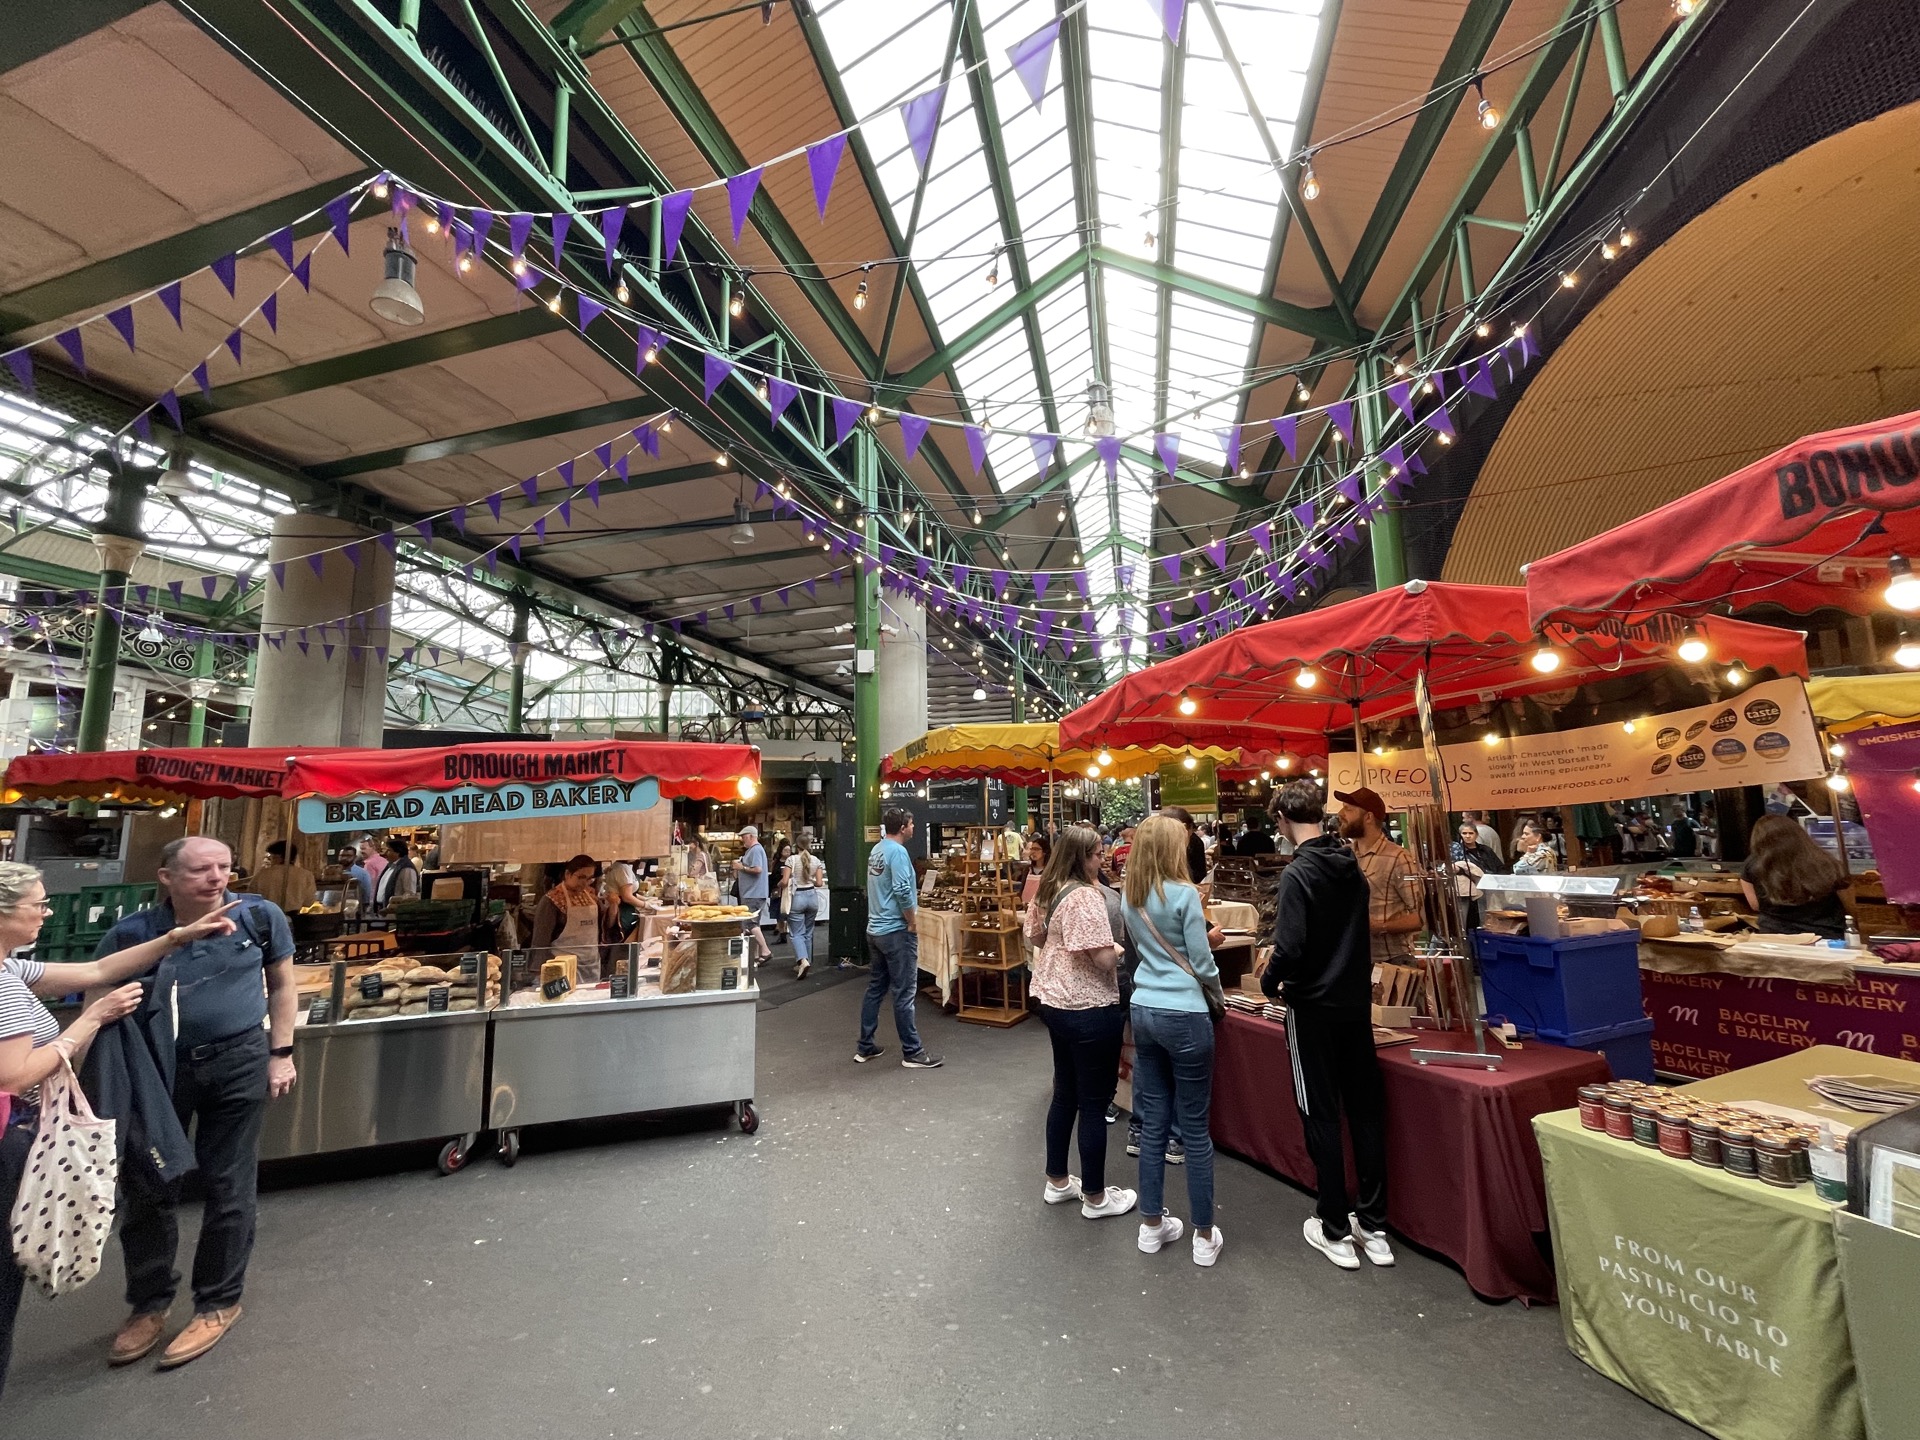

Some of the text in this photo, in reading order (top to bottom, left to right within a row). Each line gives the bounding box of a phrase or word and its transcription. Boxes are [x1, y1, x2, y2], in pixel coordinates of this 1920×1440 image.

[1562, 613, 1708, 645] OUGH MART
[1746, 708, 1780, 719] taste
[444, 749, 627, 780] BOROUGH MARKET
[1487, 754, 1518, 762] Artisan
[1520, 748, 1574, 759] Charcuterie
[1532, 759, 1555, 767] West
[1558, 755, 1590, 765] Dorset
[1593, 754, 1605, 762] by
[135, 755, 287, 788] BOROUGH MARKET
[1337, 764, 1473, 786] CAPREOUS
[1490, 762, 1613, 779] award winning epicureans
[1491, 775, 1631, 796] CAPREOLUSFINEFOODS.CO.UK
[325, 783, 636, 824] BREAD AHEAD BAKERY
[1652, 972, 1723, 990] BAKERY
[1796, 988, 1907, 1013] & BAKERY
[1719, 1008, 1810, 1032] BAGELRY
[1718, 1023, 1816, 1048] & BAKERY
[1650, 1039, 1732, 1064] BAGELRY
[1614, 1235, 1758, 1305] FROM OUR
[1598, 1256, 1789, 1347] PASTIFICIO TO
[1621, 1291, 1783, 1378] YOUR TABLE
